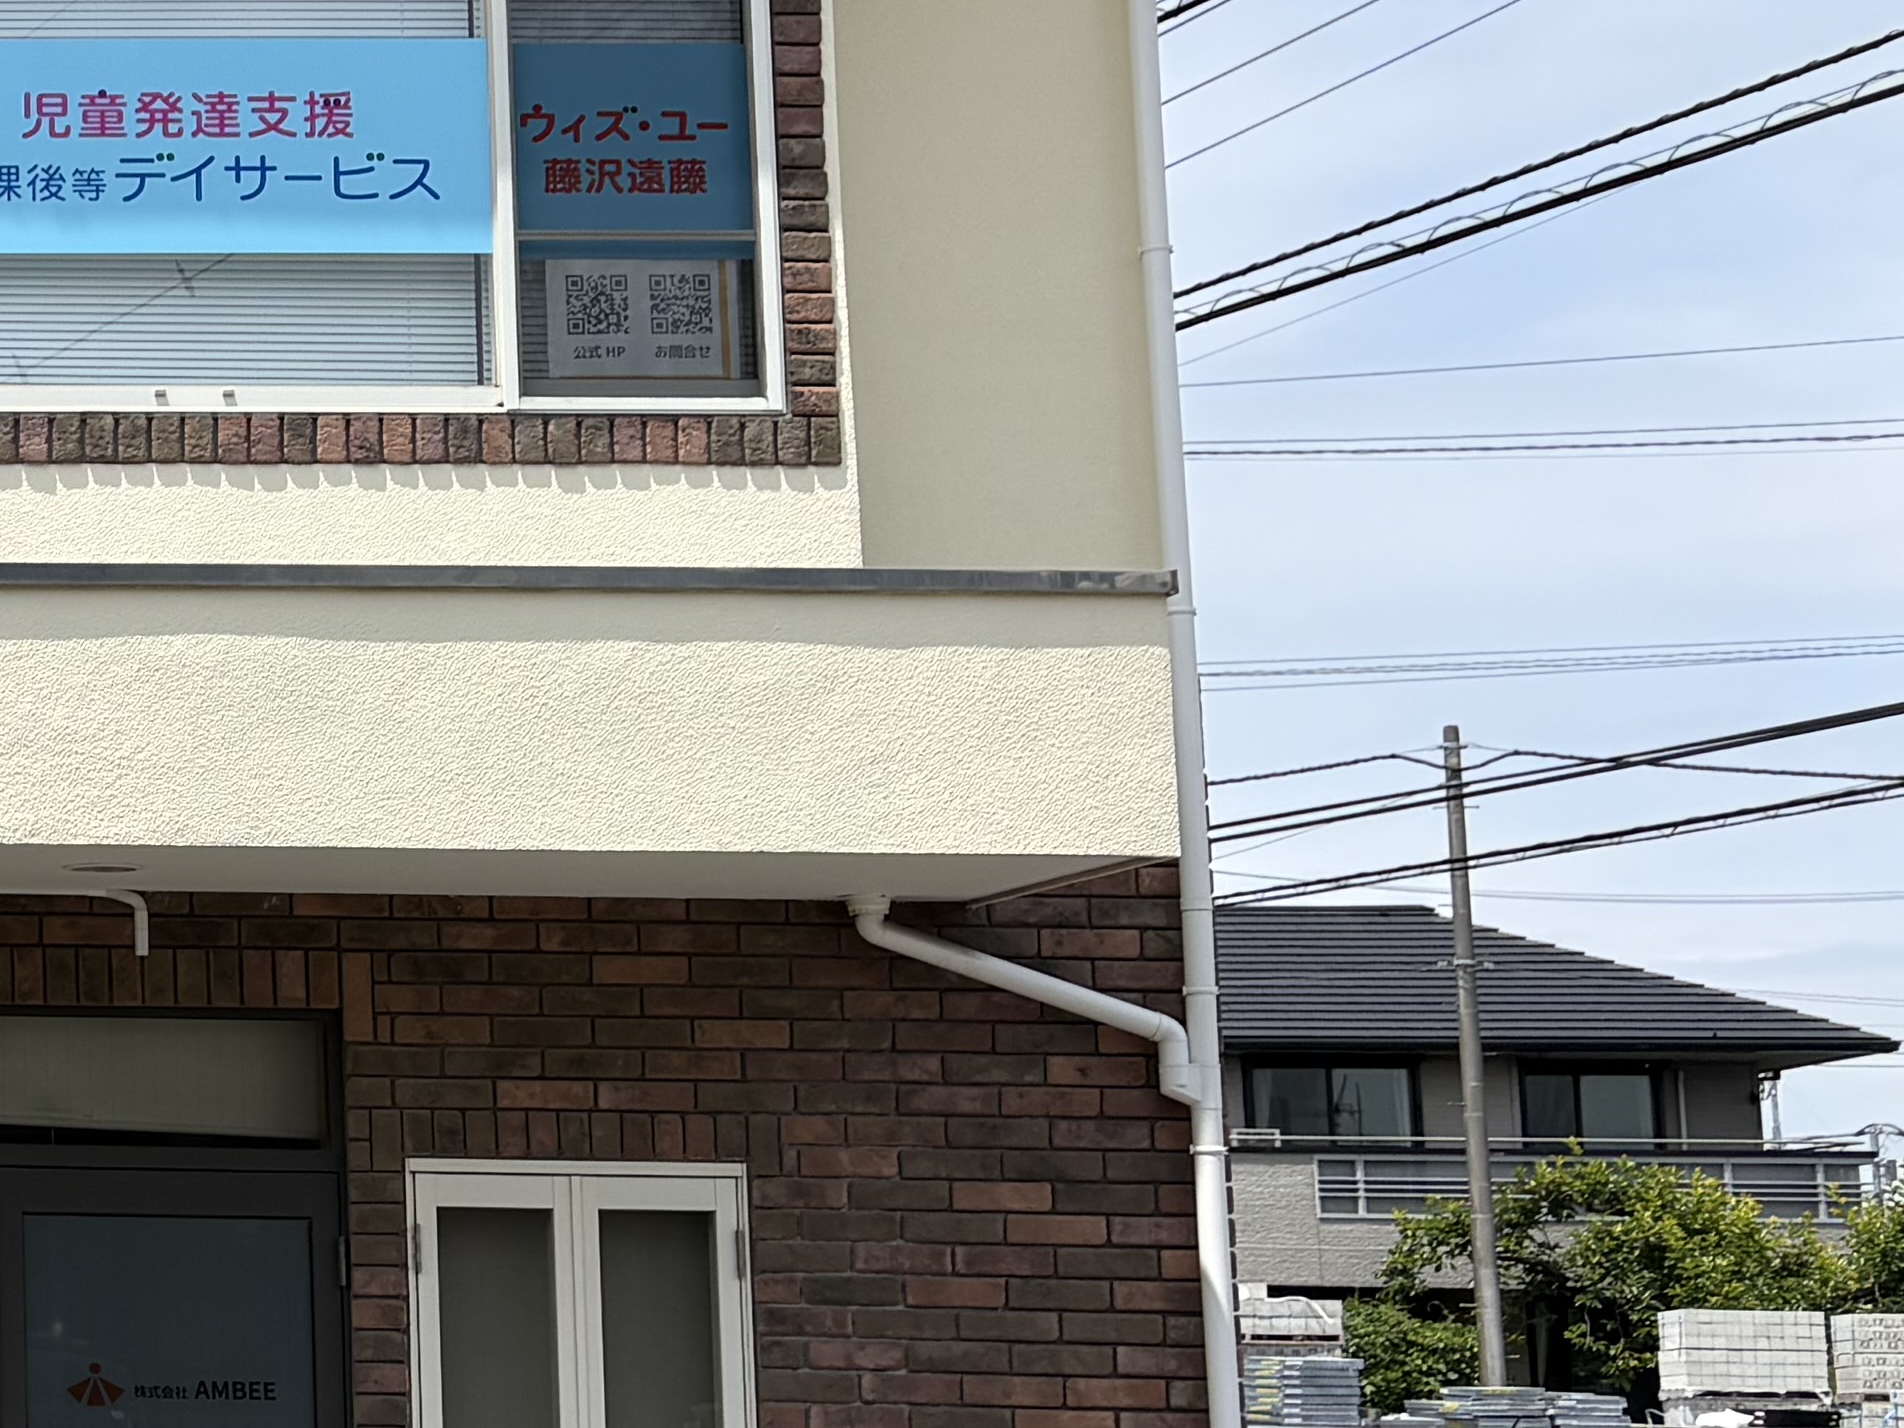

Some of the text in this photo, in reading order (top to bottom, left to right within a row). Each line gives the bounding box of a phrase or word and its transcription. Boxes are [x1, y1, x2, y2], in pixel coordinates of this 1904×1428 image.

[21, 88, 355, 139] 児童発達支援
[519, 103, 728, 143] ウィズ・ユー
[543, 158, 708, 194] 藤沢遠藤
[655, 345, 711, 359] お問合せ
[134, 1380, 277, 1401] 株式会社 AMBEE
